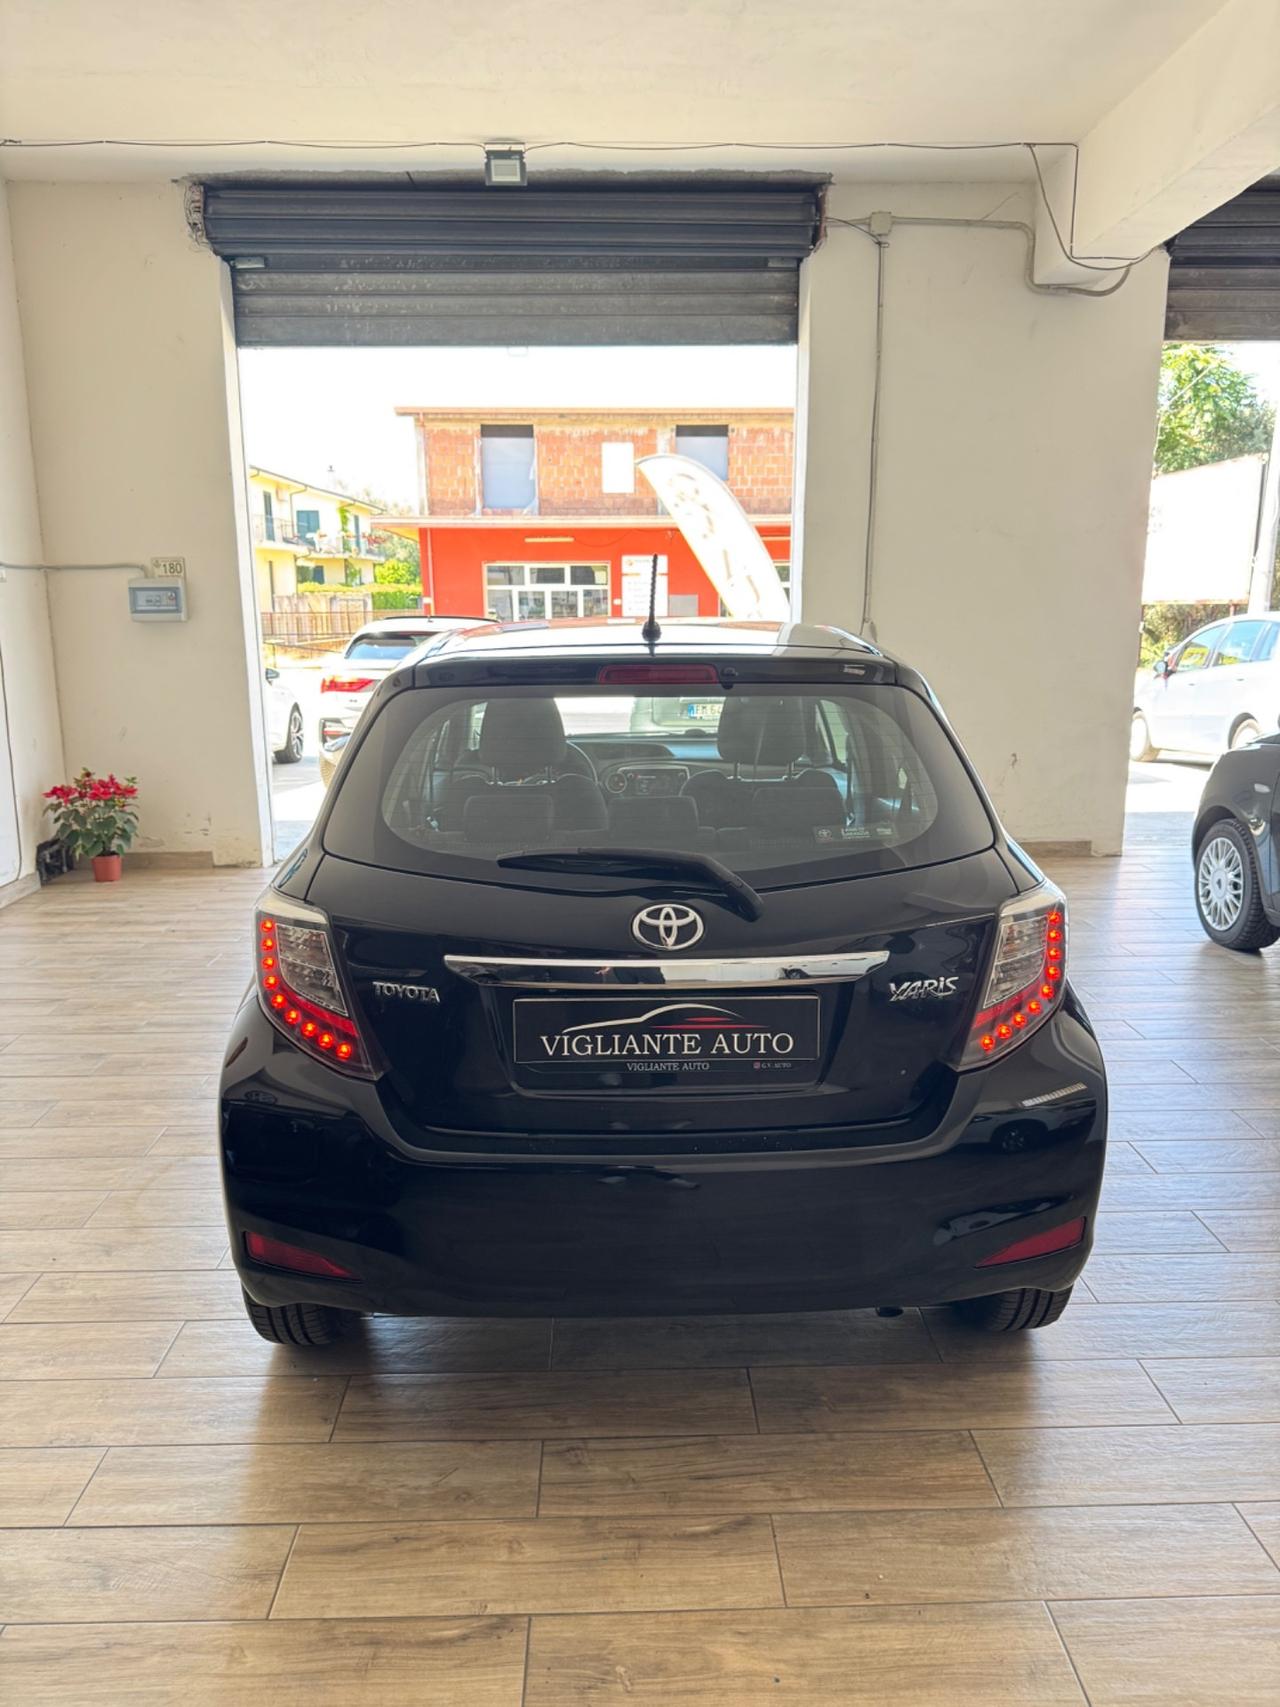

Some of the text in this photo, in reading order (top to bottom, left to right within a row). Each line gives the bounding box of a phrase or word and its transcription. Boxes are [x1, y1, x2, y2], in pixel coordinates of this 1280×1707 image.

[162, 562, 183, 574] 180
[372, 981, 440, 1003] TOYOTA
[889, 976, 959, 1001] YARIS
[540, 1032, 794, 1056] VIGLIANTE AUTO
[626, 1062, 710, 1071] VIGLIANTE AUTO
